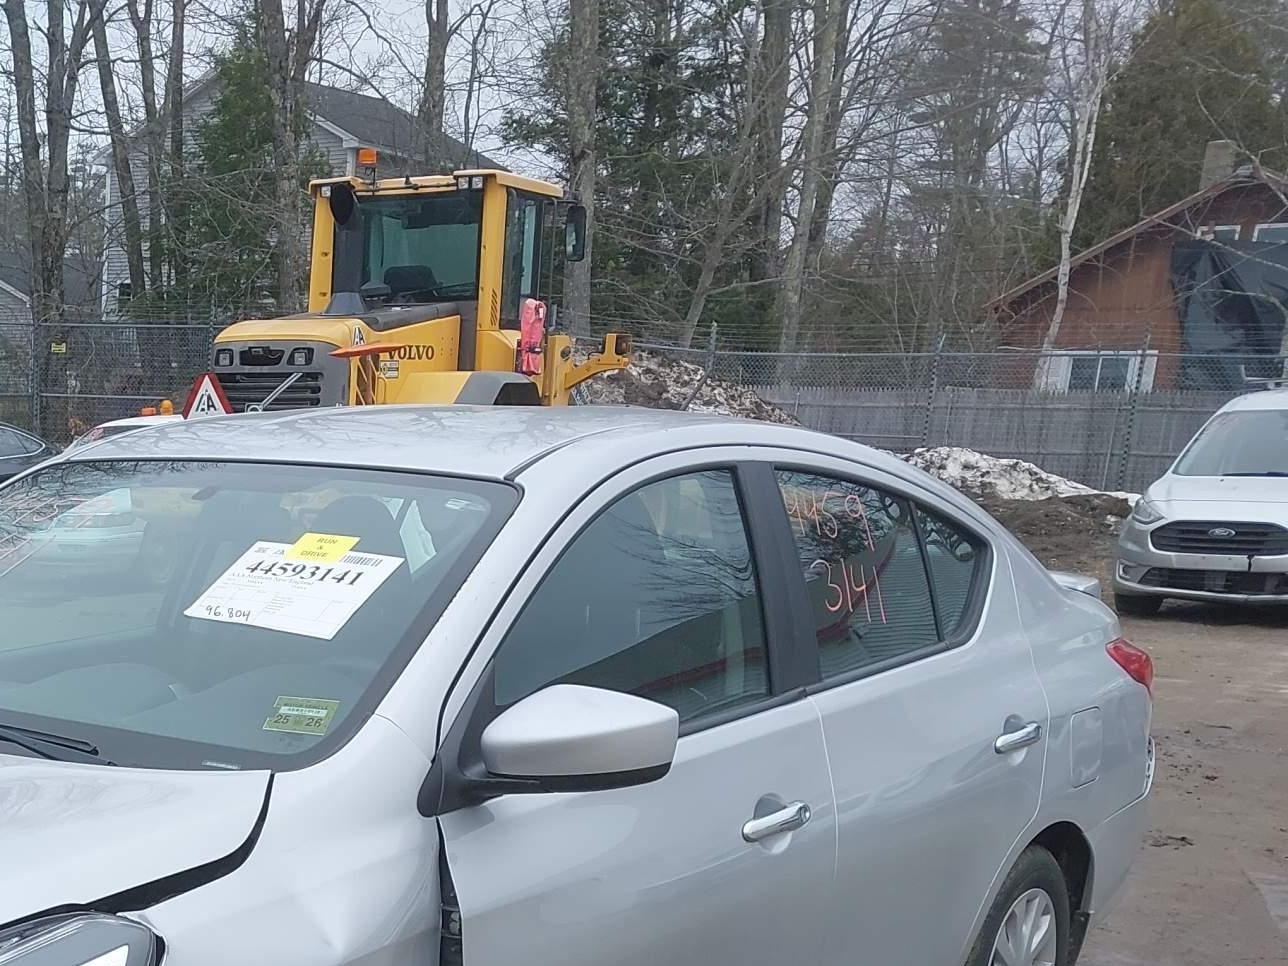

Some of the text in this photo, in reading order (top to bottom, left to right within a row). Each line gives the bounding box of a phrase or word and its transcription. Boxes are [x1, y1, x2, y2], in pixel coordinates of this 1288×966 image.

[387, 345, 435, 360] VOLVO
[300, 550, 329, 558] DRIVE
[246, 559, 364, 586] 44593141
[810, 558, 887, 625] 3141
[273, 714, 323, 728] 25 26
